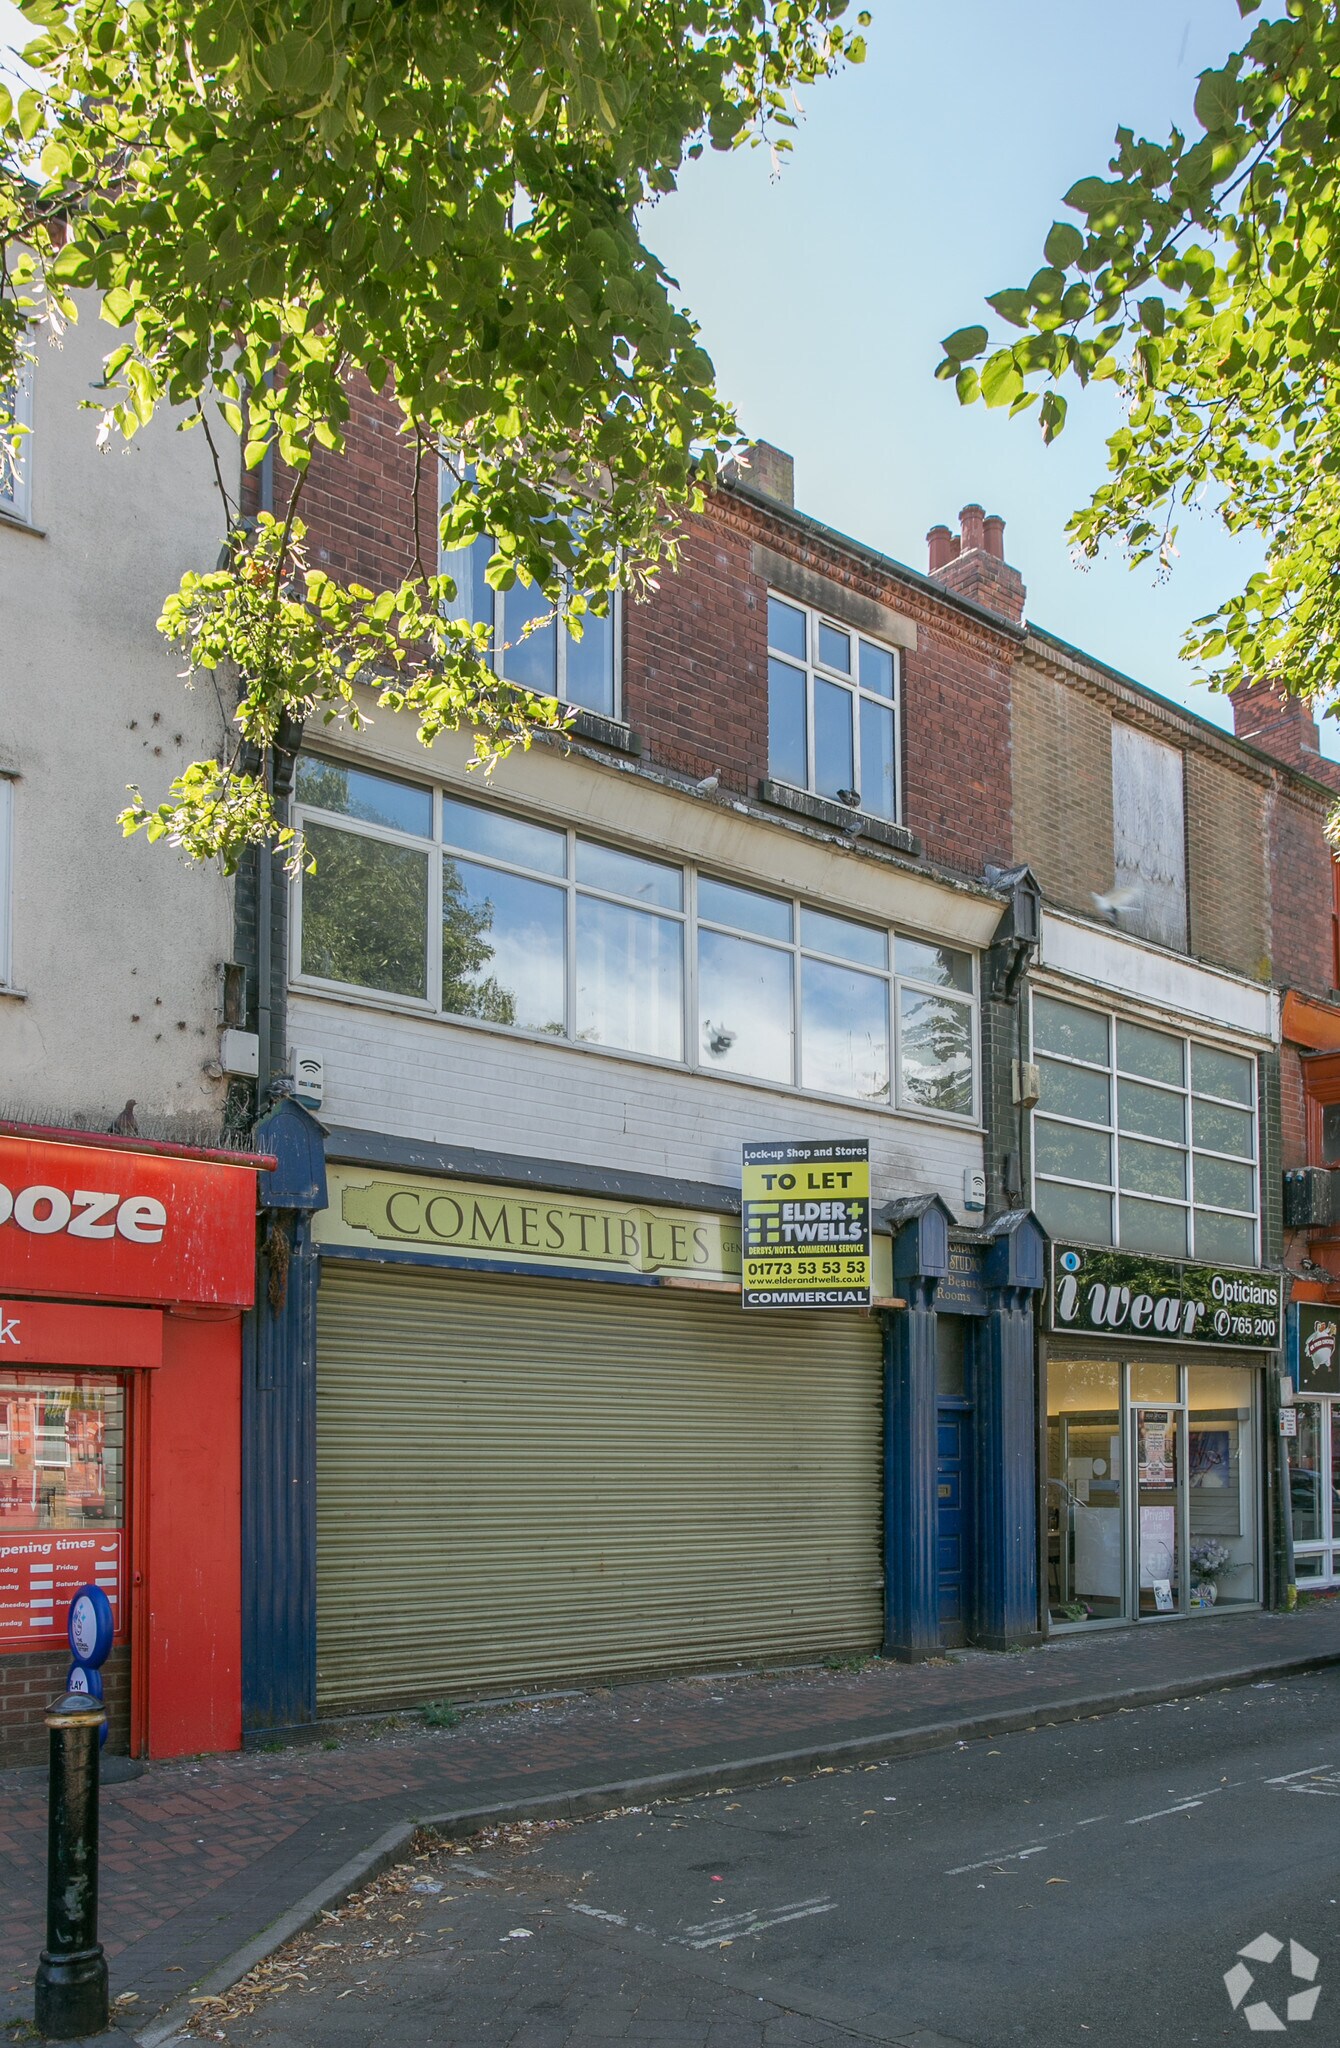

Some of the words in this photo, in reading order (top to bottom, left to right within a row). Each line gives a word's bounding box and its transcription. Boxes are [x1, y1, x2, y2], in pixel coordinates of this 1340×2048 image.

[744, 1150, 784, 1161] Lock-up
[786, 1148, 811, 1159] Shop
[813, 1147, 832, 1156] and
[835, 1146, 867, 1156] Stores
[761, 1173, 797, 1190] TO
[807, 1171, 852, 1189] LET
[0, 1182, 167, 1243] oze
[386, 1191, 710, 1265] COMESTIBLES
[781, 1222, 862, 1242] TWELLS
[797, 1244, 838, 1254] COMMERCIAL
[838, 1244, 864, 1253] SERVICE
[748, 1262, 792, 1275] 01773
[797, 1261, 816, 1274] 53
[822, 1261, 841, 1274] 53
[846, 1261, 865, 1274] 53
[748, 1274, 865, 1285] www.elderandtwells.co.uk
[747, 1290, 867, 1303] COMMERCIAL
[937, 1287, 971, 1302] Rooms
[1211, 1275, 1278, 1306] Opticians
[1088, 1284, 1206, 1334] wear
[1231, 1316, 1252, 1334] 765
[1254, 1318, 1276, 1337] 200
[56, 1539, 95, 1550] times
